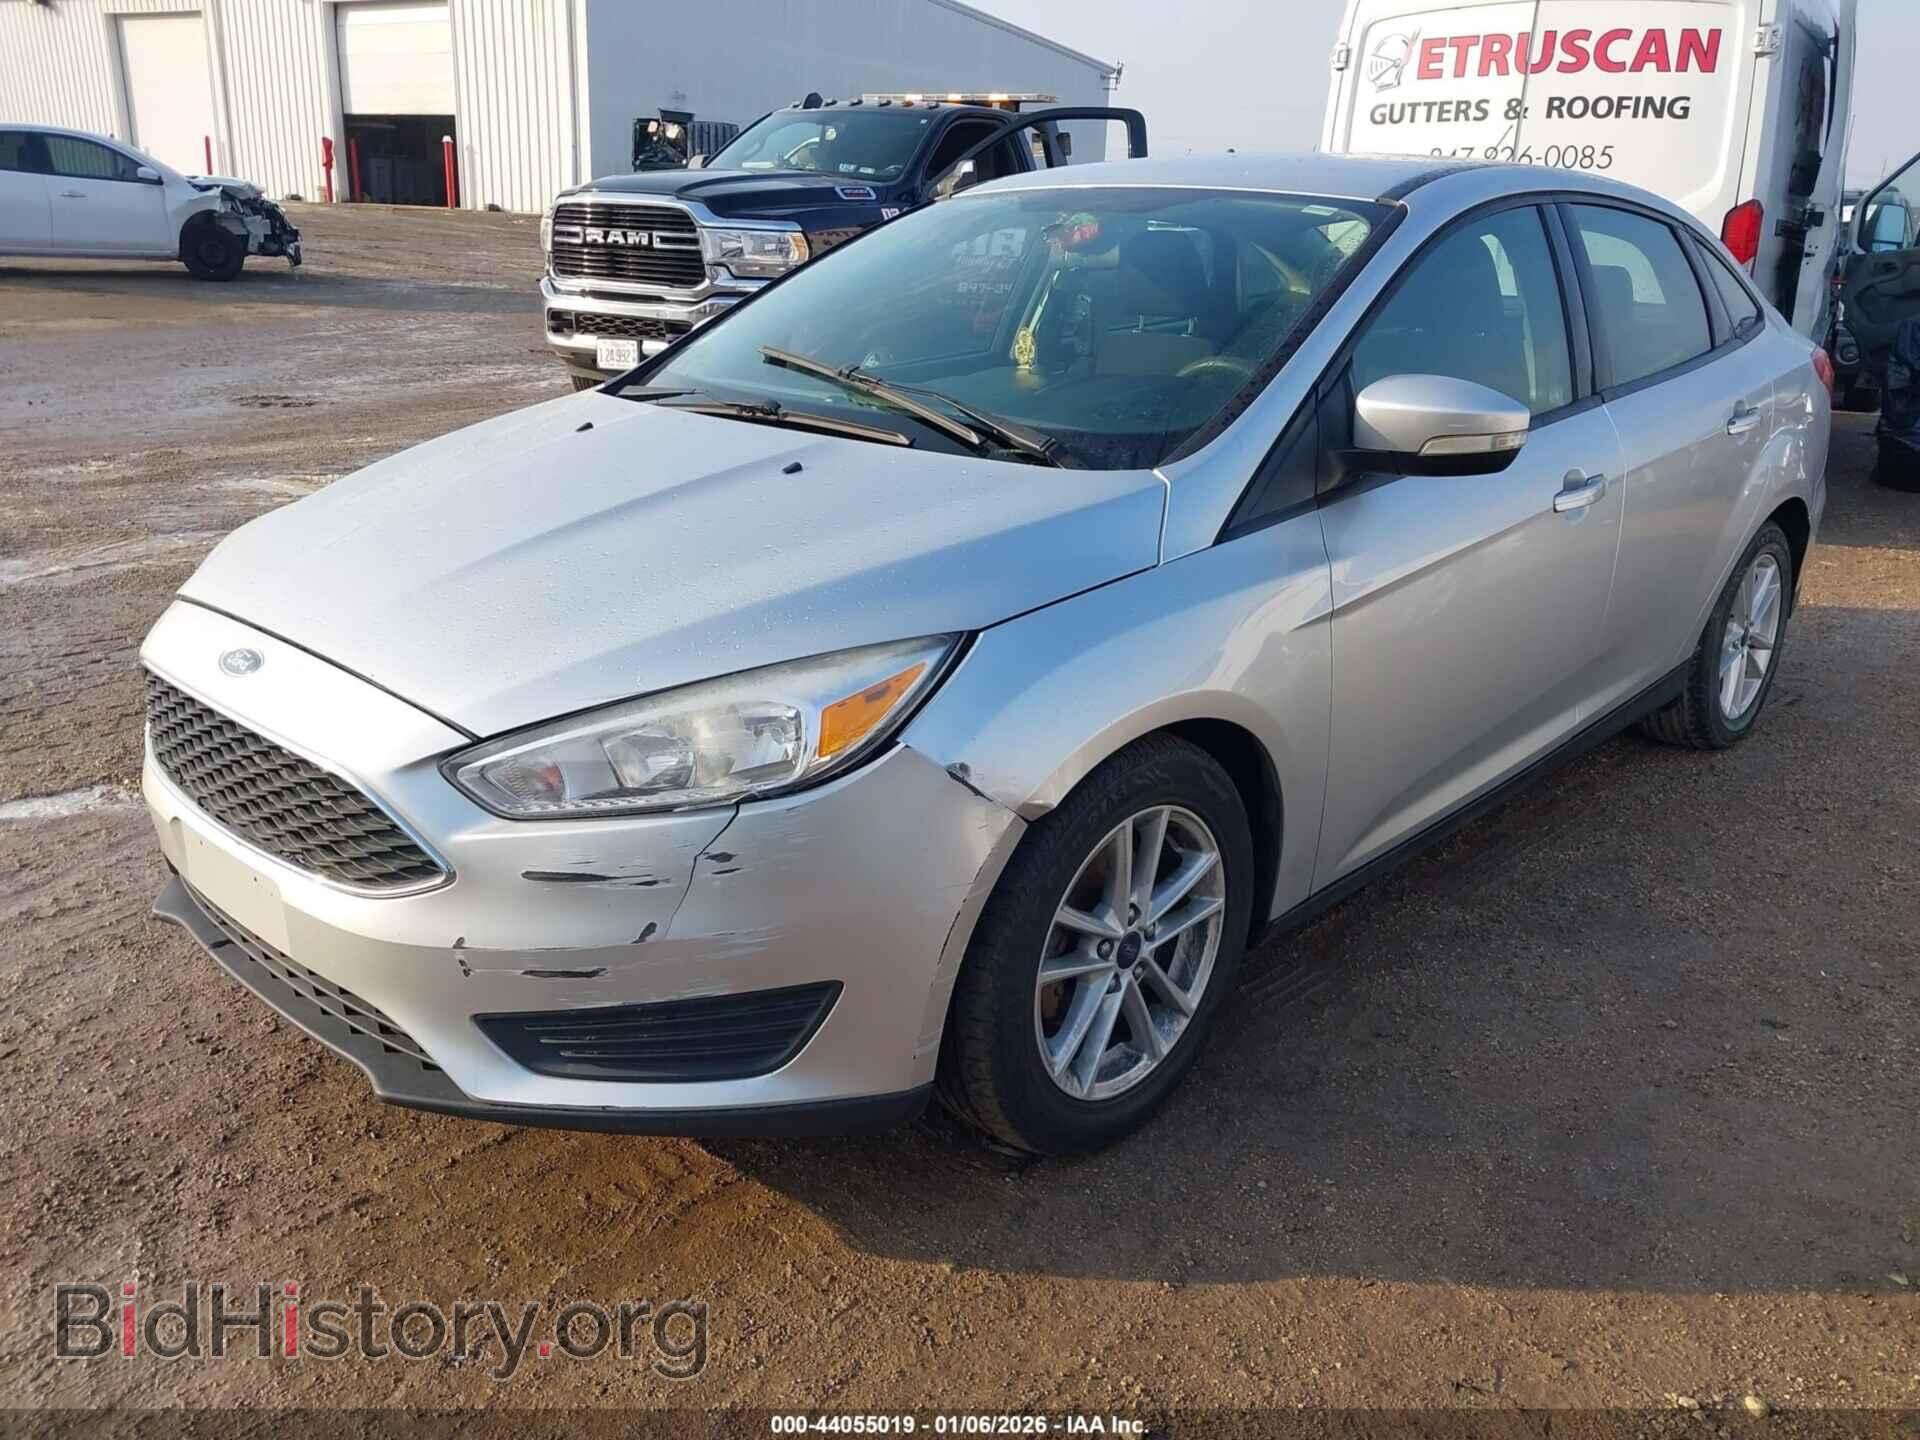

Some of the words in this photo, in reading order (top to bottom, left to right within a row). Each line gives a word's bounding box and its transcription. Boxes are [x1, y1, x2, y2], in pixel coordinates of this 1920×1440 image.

[1417, 28, 1722, 80] ETRUSCAN
[1369, 98, 1490, 125] GUTTERS
[1503, 98, 1529, 121] &
[1545, 96, 1691, 120] ROOFING
[585, 229, 649, 245] RAM
